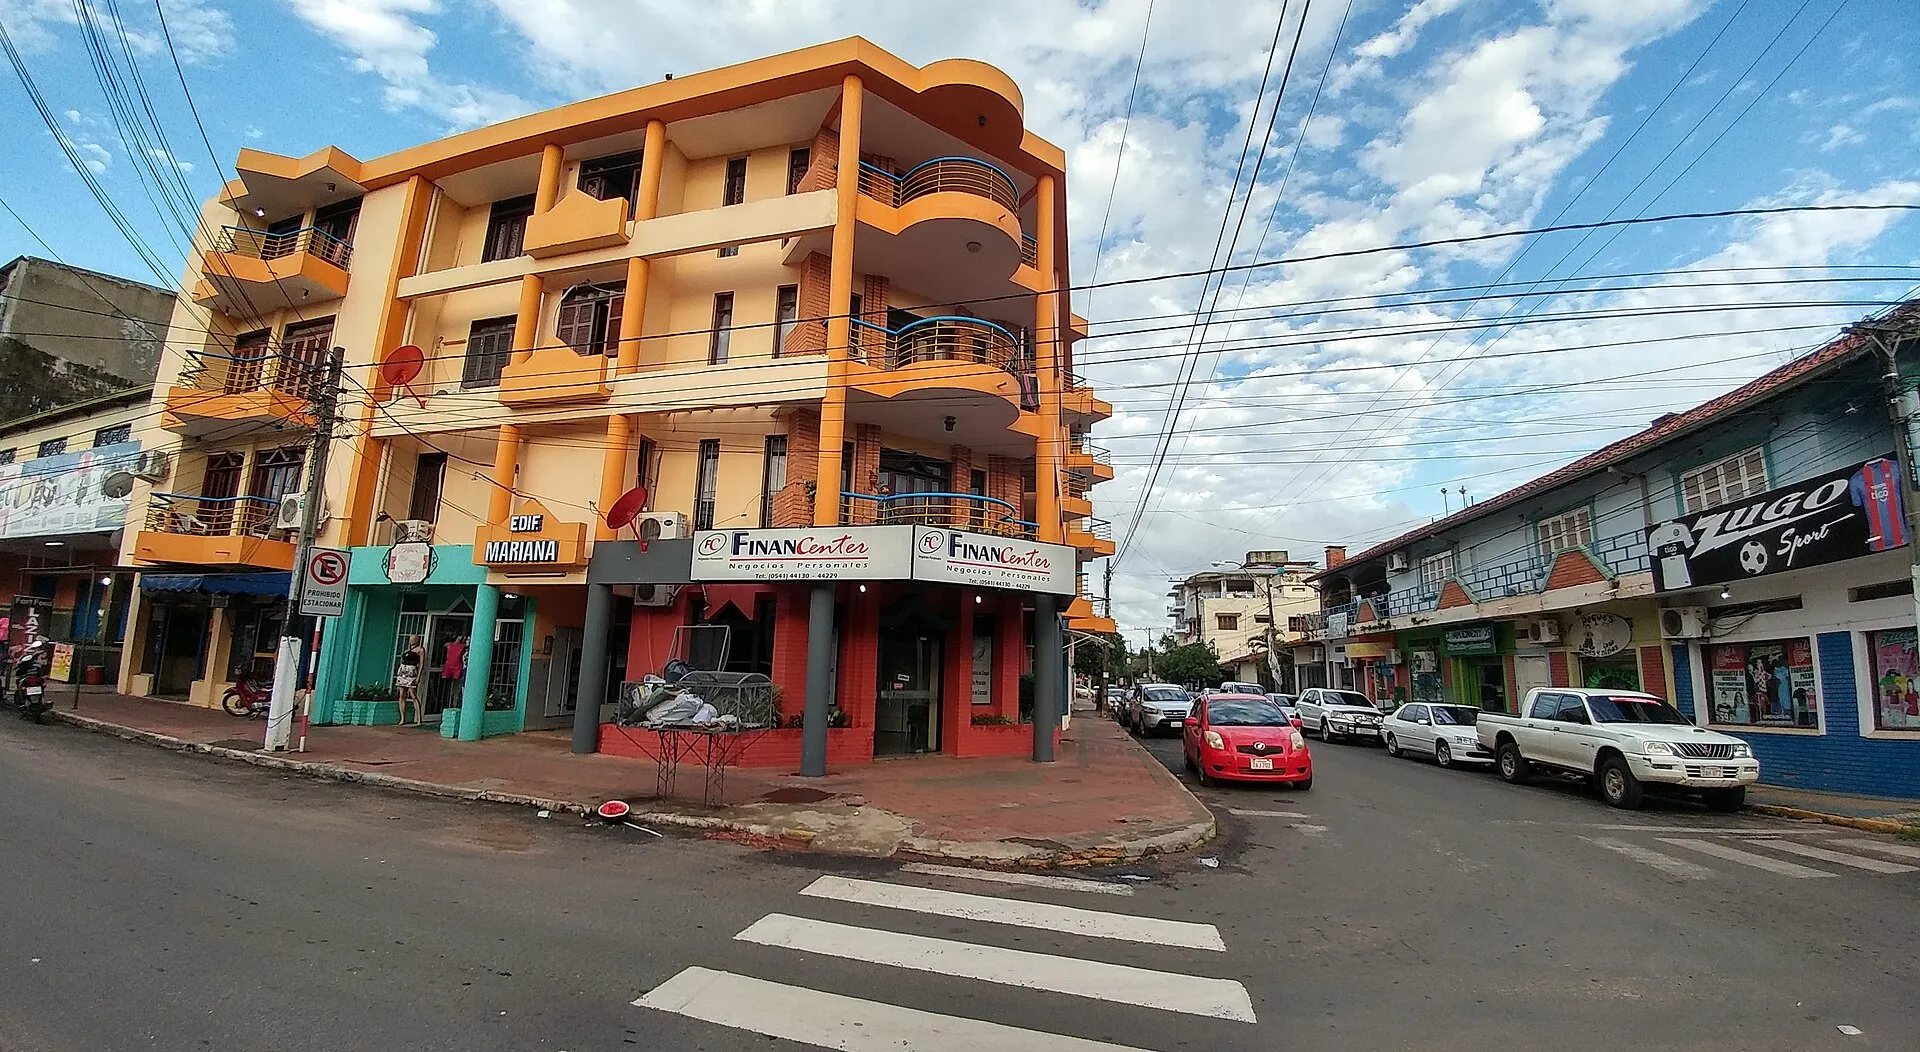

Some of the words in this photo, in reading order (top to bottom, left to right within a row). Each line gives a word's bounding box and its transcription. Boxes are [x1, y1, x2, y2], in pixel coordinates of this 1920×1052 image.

[1690, 479, 1849, 559] ZUGO
[1777, 513, 1856, 567] Sport
[485, 540, 556, 562] MARIANA
[728, 563, 785, 571] Negocios
[946, 565, 992, 575] Negocios
[1001, 570, 1051, 583] Personales
[307, 589, 341, 599] PROHIBIDO
[303, 599, 342, 608] ESTACIONAR
